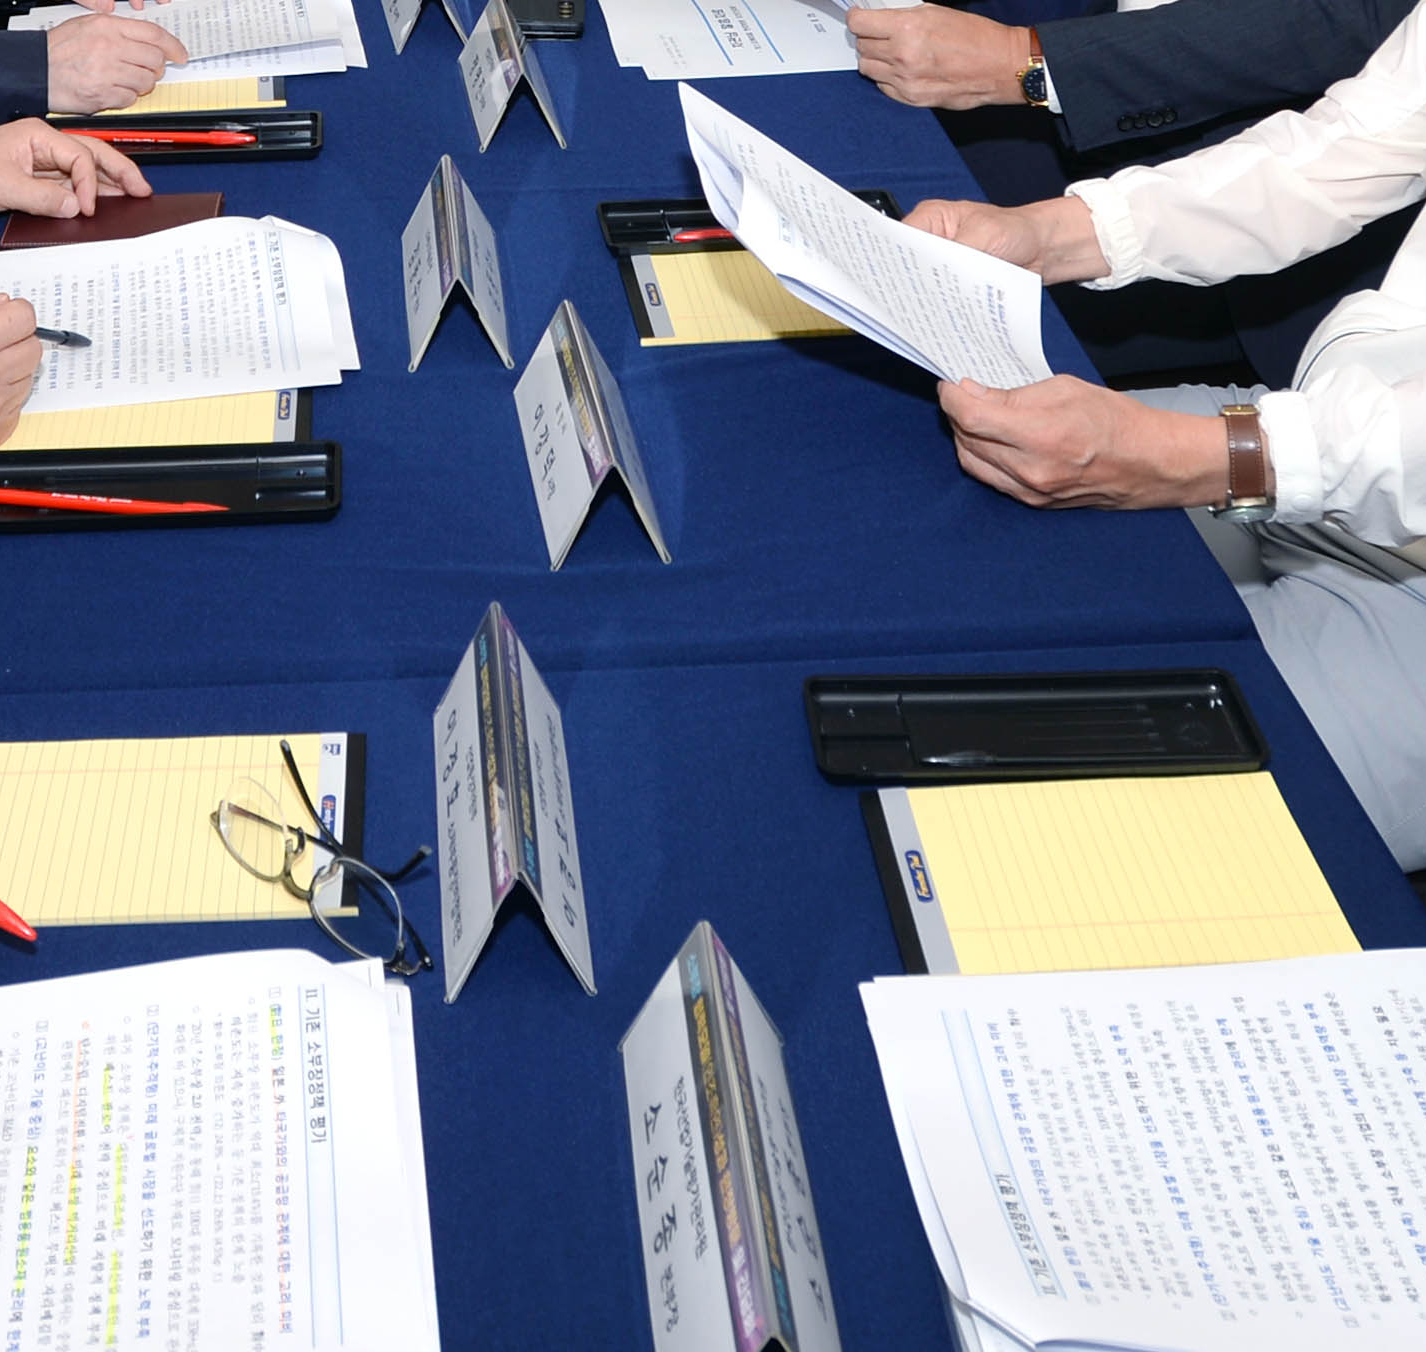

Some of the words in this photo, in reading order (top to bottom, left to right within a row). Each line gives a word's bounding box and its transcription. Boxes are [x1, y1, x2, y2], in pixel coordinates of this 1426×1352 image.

[303, 1007, 322, 1032] 기존
[304, 1040, 326, 1109] 소부장정책
[308, 1116, 328, 1143] 평가
